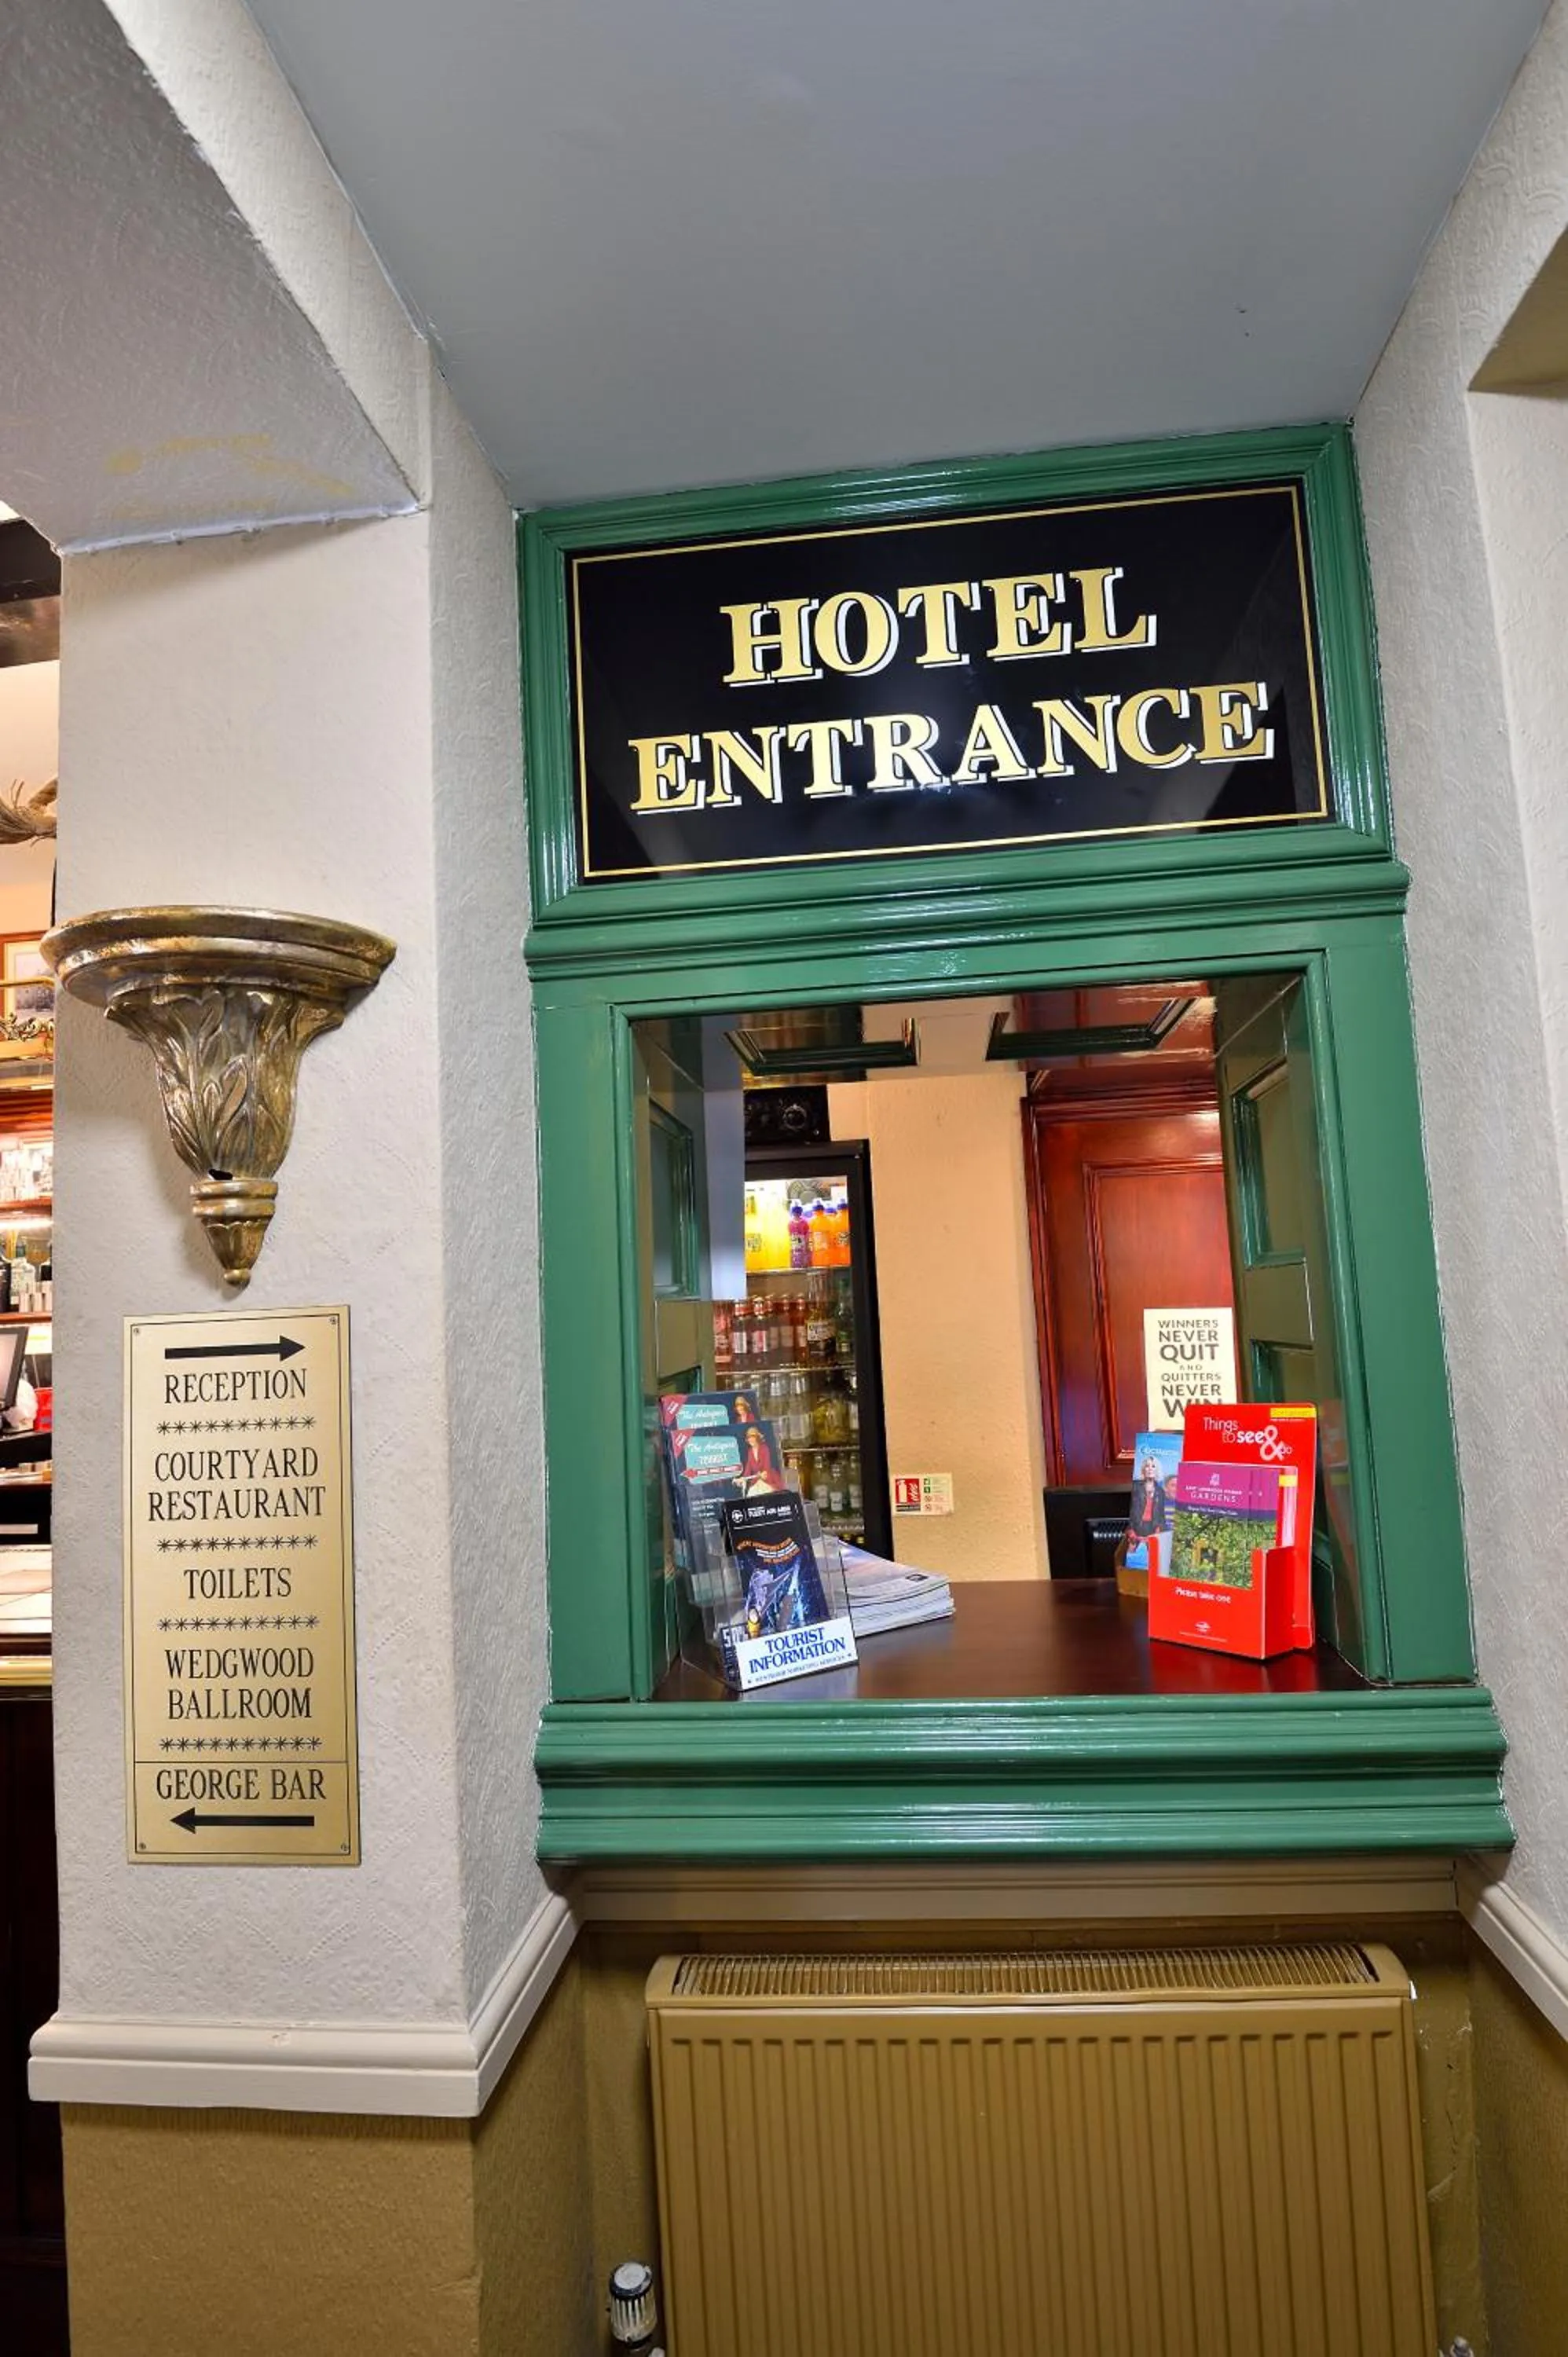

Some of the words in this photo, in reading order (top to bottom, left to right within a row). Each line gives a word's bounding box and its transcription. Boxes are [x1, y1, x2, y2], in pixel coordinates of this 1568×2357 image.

[720, 566, 1156, 687] HOTEL
[628, 680, 1275, 815] ENTRANCE
[1158, 1319, 1218, 1329] WINNERS
[1159, 1330, 1218, 1343] NEVER
[1160, 1343, 1219, 1364] QUIT
[163, 1368, 307, 1404] RECEPTION
[1161, 1373, 1222, 1383] QUITTERS
[1161, 1384, 1222, 1396] NEVER
[1203, 1417, 1239, 1433] Things
[1222, 1431, 1236, 1443] to
[1236, 1431, 1264, 1444] see
[155, 1446, 319, 1482] COURTYARD
[148, 1486, 326, 1522] RESTAURANT
[1190, 1492, 1237, 1503] GARDENS
[184, 1567, 292, 1599] TOILETS
[749, 1637, 847, 1674] INFORMATION
[765, 1626, 826, 1654] TOURIST
[164, 1647, 314, 1679] WEDGWOOD
[168, 1687, 312, 1720] BALLROOM
[156, 1769, 260, 1800] GEORGE
[271, 1769, 327, 1800] BAR
